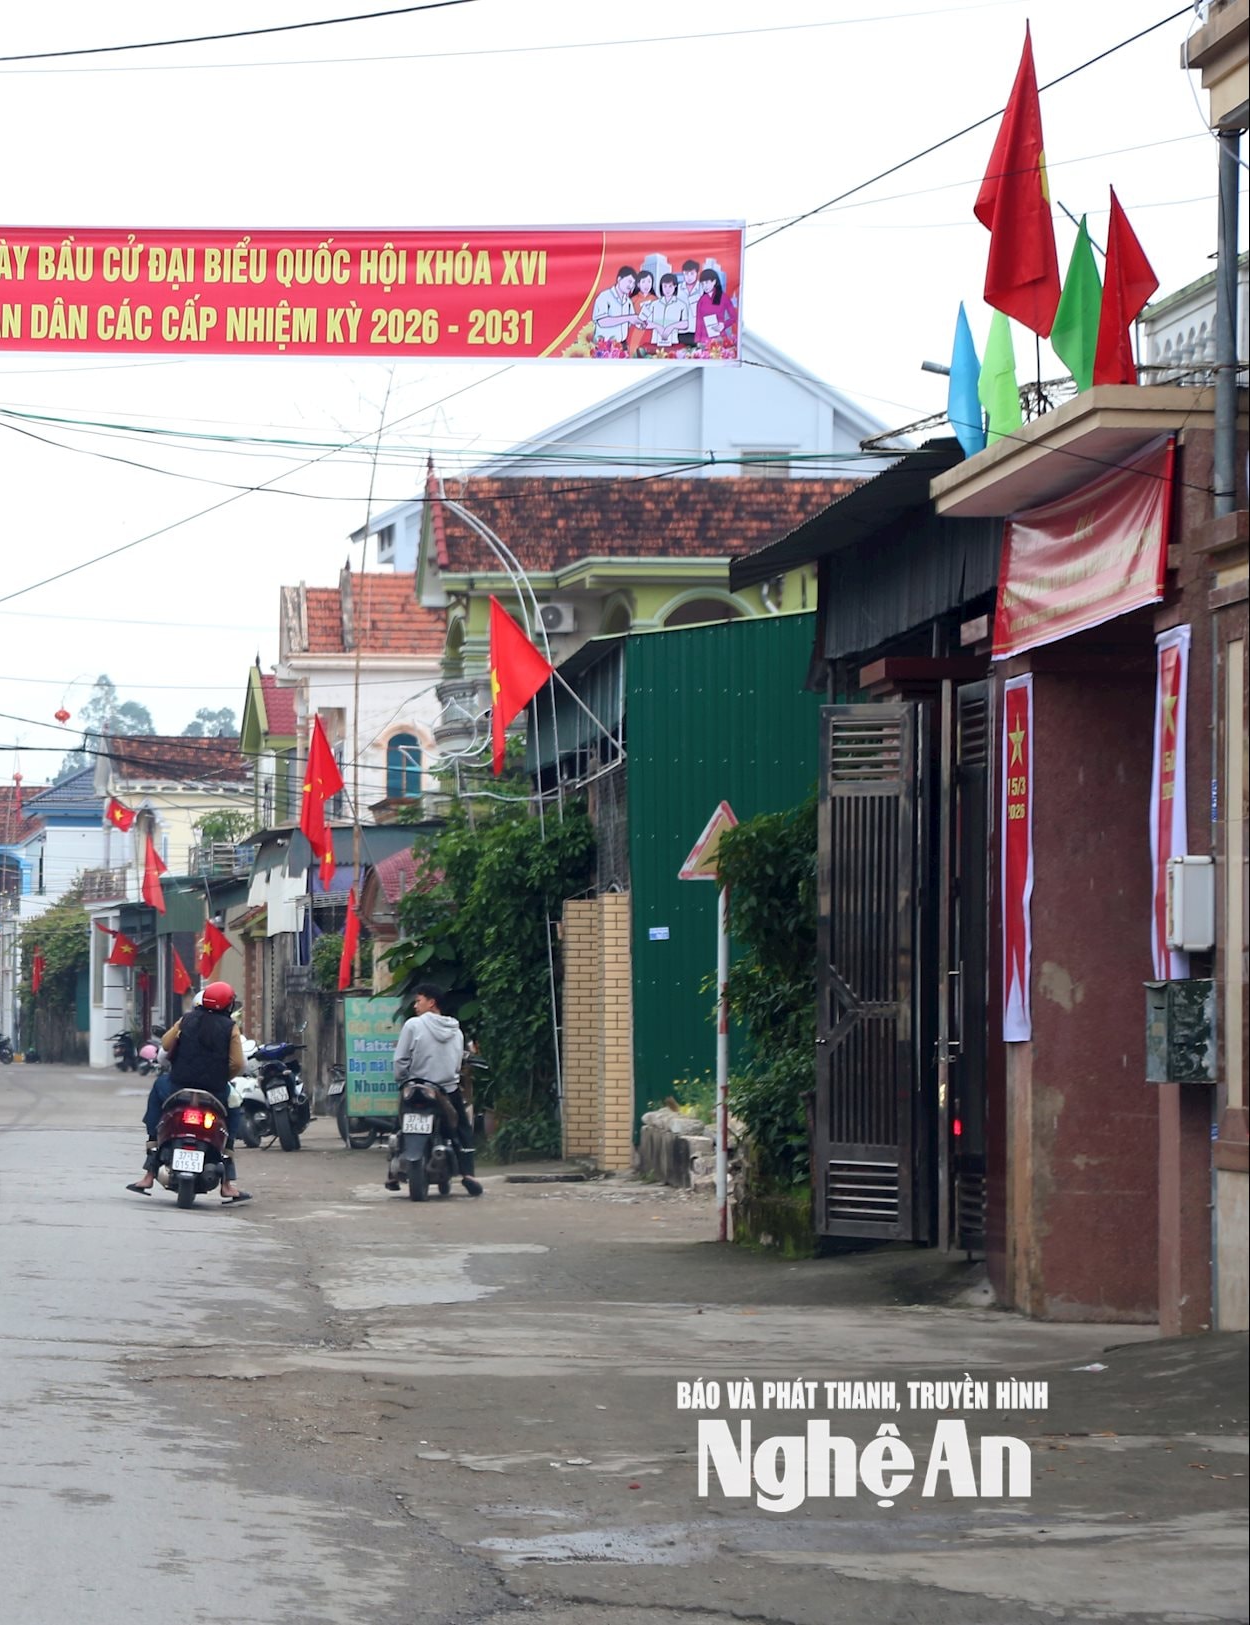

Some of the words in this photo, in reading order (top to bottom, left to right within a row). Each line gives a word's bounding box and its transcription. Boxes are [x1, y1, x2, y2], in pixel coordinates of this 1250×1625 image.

[37, 236, 94, 282] BẦU
[102, 233, 144, 283] CỬ
[147, 246, 195, 291] ĐẠI
[203, 236, 267, 284] BIỂU
[275, 239, 351, 288] QUỐC
[359, 242, 407, 293] HỘI
[415, 242, 492, 286] KHÓA
[500, 250, 547, 286] XVI
[30, 296, 88, 340] DÂN
[97, 298, 153, 342] CÁC
[161, 294, 218, 342] CẤP
[225, 299, 318, 351] NHIỆM
[326, 300, 363, 343] KỲ
[370, 308, 439, 345] 2026
[467, 308, 533, 345] 2031
